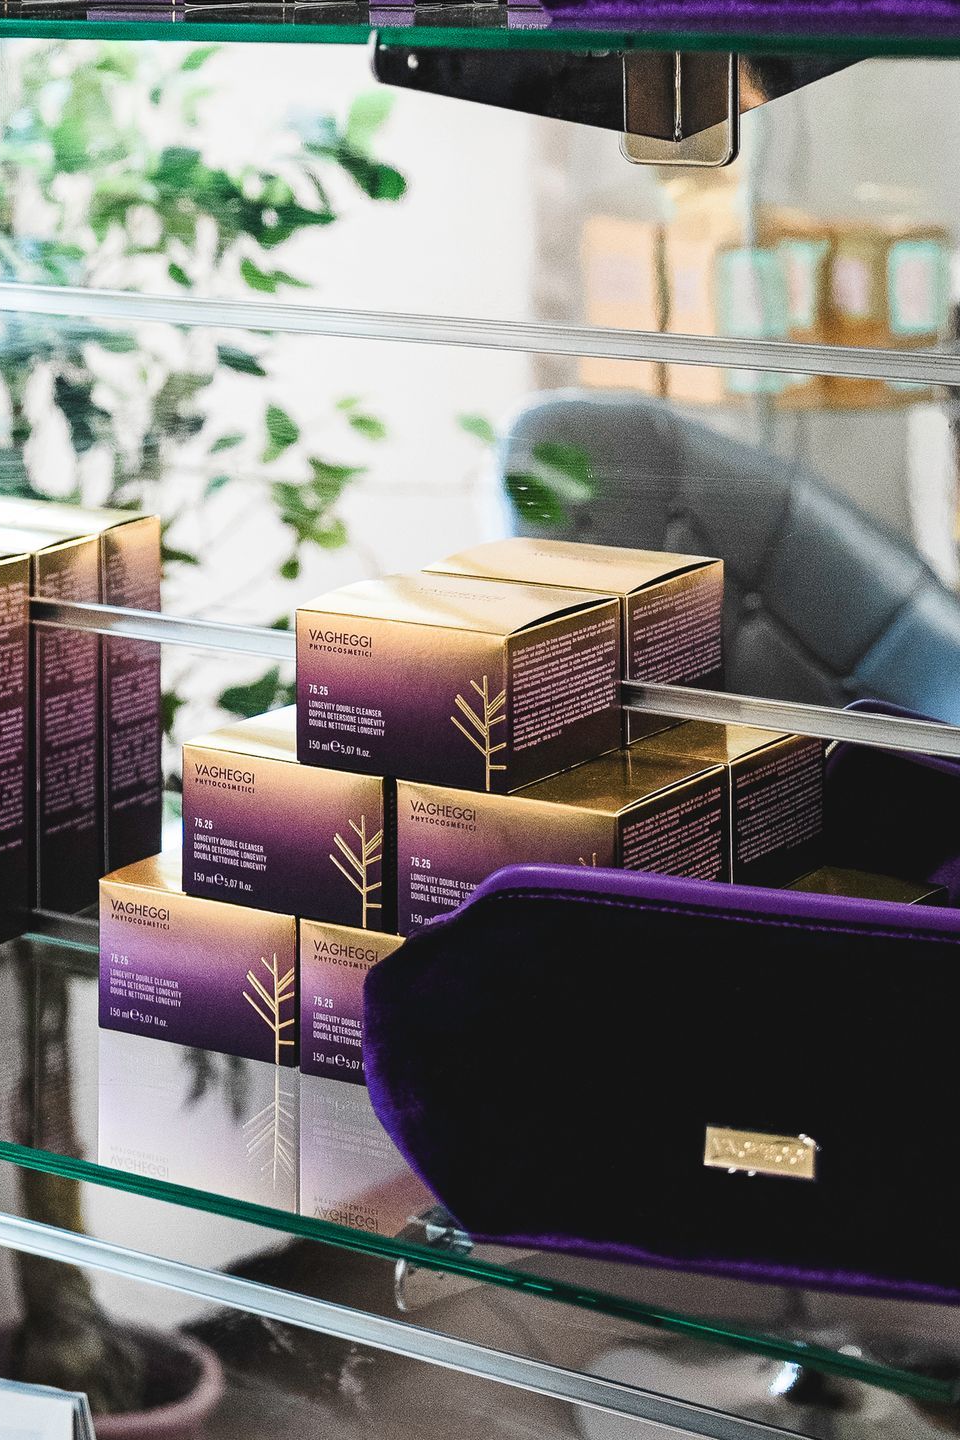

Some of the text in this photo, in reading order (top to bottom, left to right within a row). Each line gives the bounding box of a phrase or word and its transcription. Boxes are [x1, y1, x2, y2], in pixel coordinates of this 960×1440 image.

[308, 629, 372, 648] VAGHEGGI
[309, 643, 372, 658] PHYTOCOSMETICI
[309, 684, 329, 696] 75.25
[308, 700, 382, 718] LONGEVITY DOUBLE CLEANSER
[309, 709, 386, 728] DOPPIA DETERSIONE LONGEVITY
[309, 718, 385, 737] DOUBLE NETTOYAGE LONGEVITY
[308, 740, 321, 750] 150
[321, 743, 330, 751] ml
[195, 763, 255, 785] VAGHEGGI
[195, 777, 255, 794] PHYTOCOSMETICI
[410, 800, 476, 822] VAGHEGGI
[194, 818, 213, 830] 75.25
[411, 815, 477, 832] PHYTOCOSMETICI
[193, 833, 264, 853] LONGEVITY DOUBLE CLEANSER
[193, 842, 267, 863] DOPPIA DETERSIONE LONGEVITY
[193, 851, 267, 872] DOUBLE NETTOYAGE LONGEVITY
[410, 857, 431, 869] 75.25
[194, 872, 205, 882] 150
[206, 876, 214, 884] ml
[410, 873, 438, 884] LONGEVITY
[439, 878, 459, 888] DOUBLE
[410, 882, 429, 892] DOPPIA
[430, 885, 460, 898] DETERSIONE
[411, 892, 430, 902] DOUBLE
[431, 895, 460, 907] NETTOYAGE
[111, 899, 170, 921] VAGHEGGI
[111, 914, 170, 930] PHYTOCOSMETICI
[411, 914, 423, 924] 150
[110, 953, 129, 965] 75.25
[313, 940, 378, 963] VAGHEGGI
[314, 955, 372, 971] PHYTOCOSMETI
[154, 977, 179, 989] CLEANSER
[156, 987, 182, 998] LONGEVITY
[155, 996, 182, 1008] LONGEVITY
[313, 996, 334, 1008] 75.25
[110, 1007, 121, 1017] 150
[313, 1012, 361, 1028] LONGEVITY DOUBLE
[313, 1021, 362, 1038] DOPPIA DETERSIONE
[313, 1031, 362, 1047] DOUBLE NETTOYAGE
[313, 1052, 325, 1062] 150
[326, 1056, 334, 1064] ml
